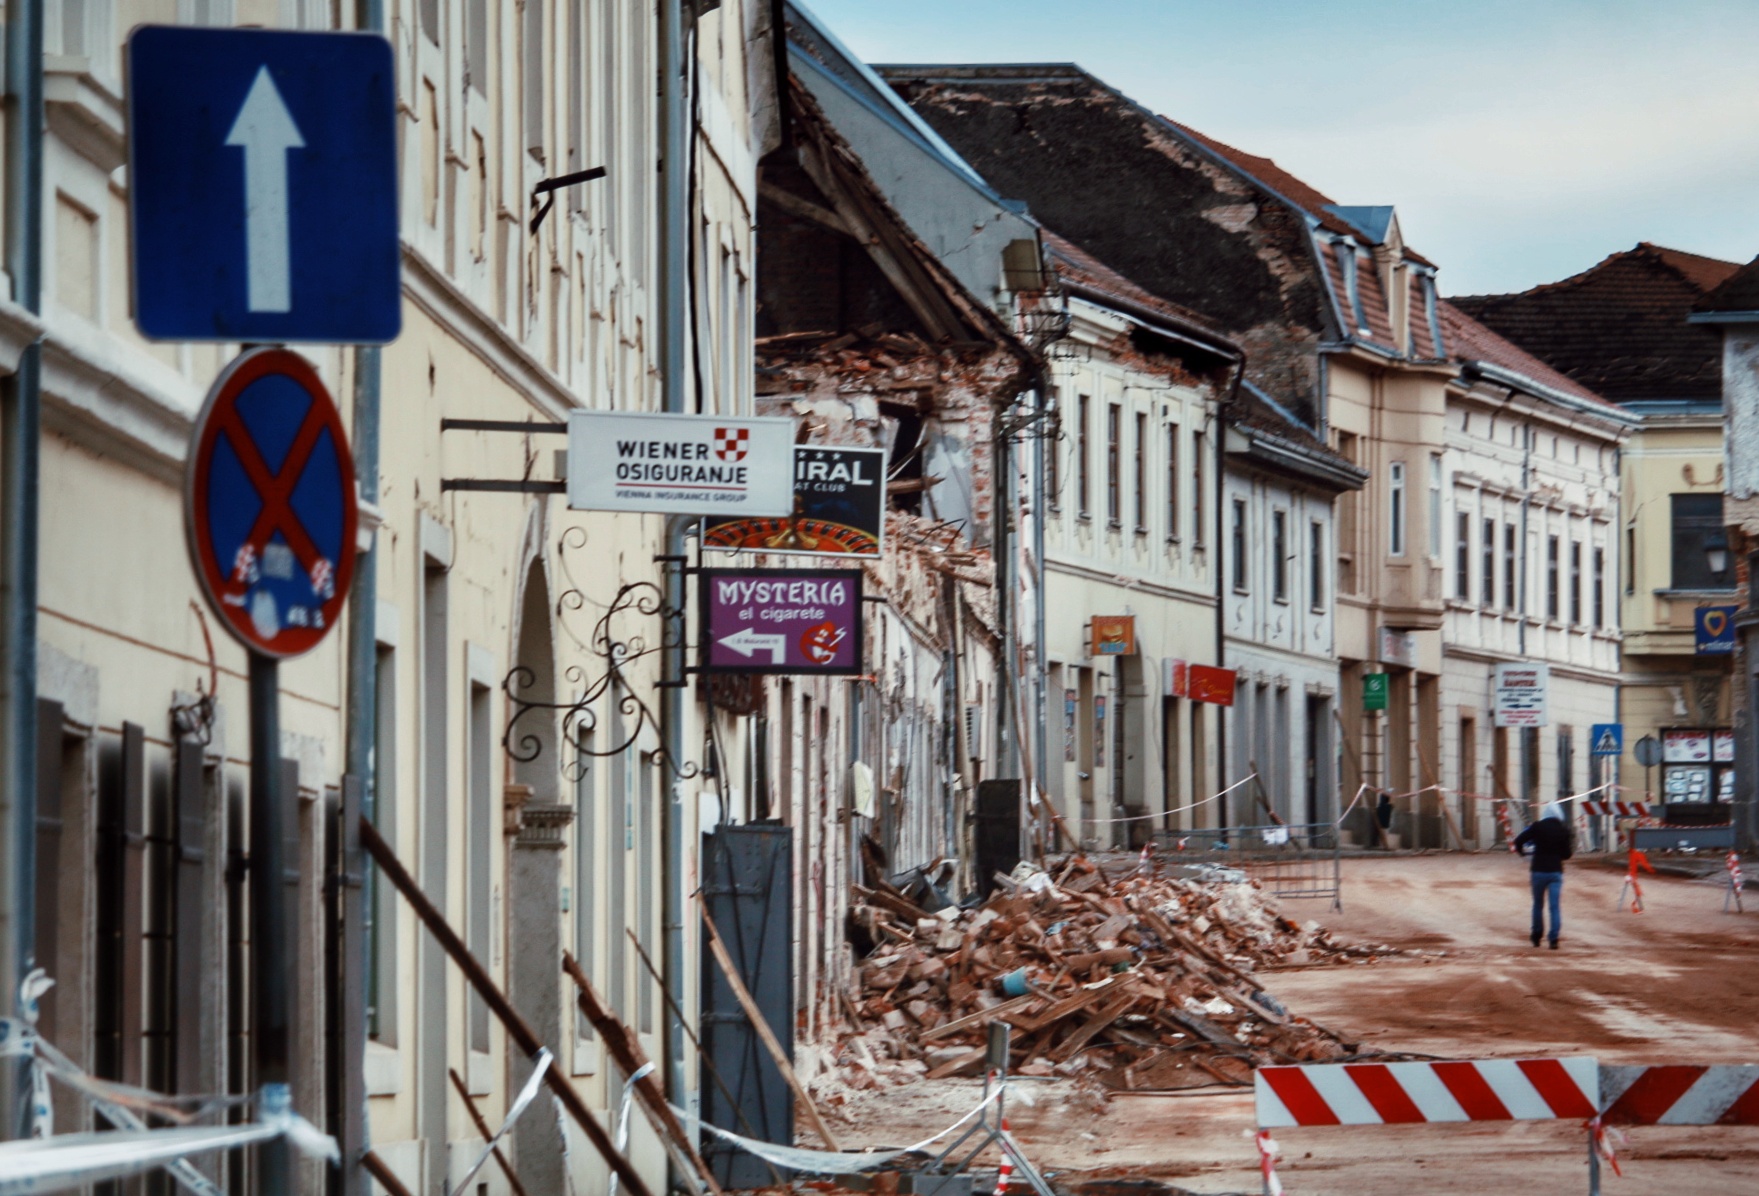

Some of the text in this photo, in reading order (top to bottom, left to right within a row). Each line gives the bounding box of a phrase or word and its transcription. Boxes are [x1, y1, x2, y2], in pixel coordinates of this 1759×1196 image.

[616, 440, 709, 460] WIENER
[616, 462, 748, 484] OSIGURANJE
[797, 460, 874, 486] IRAL
[615, 489, 748, 503] VIENNA INSURANCE GROUP
[794, 481, 847, 493] AT CLUB
[717, 579, 846, 606] MYSTERIA
[738, 606, 825, 623] el cigarete
